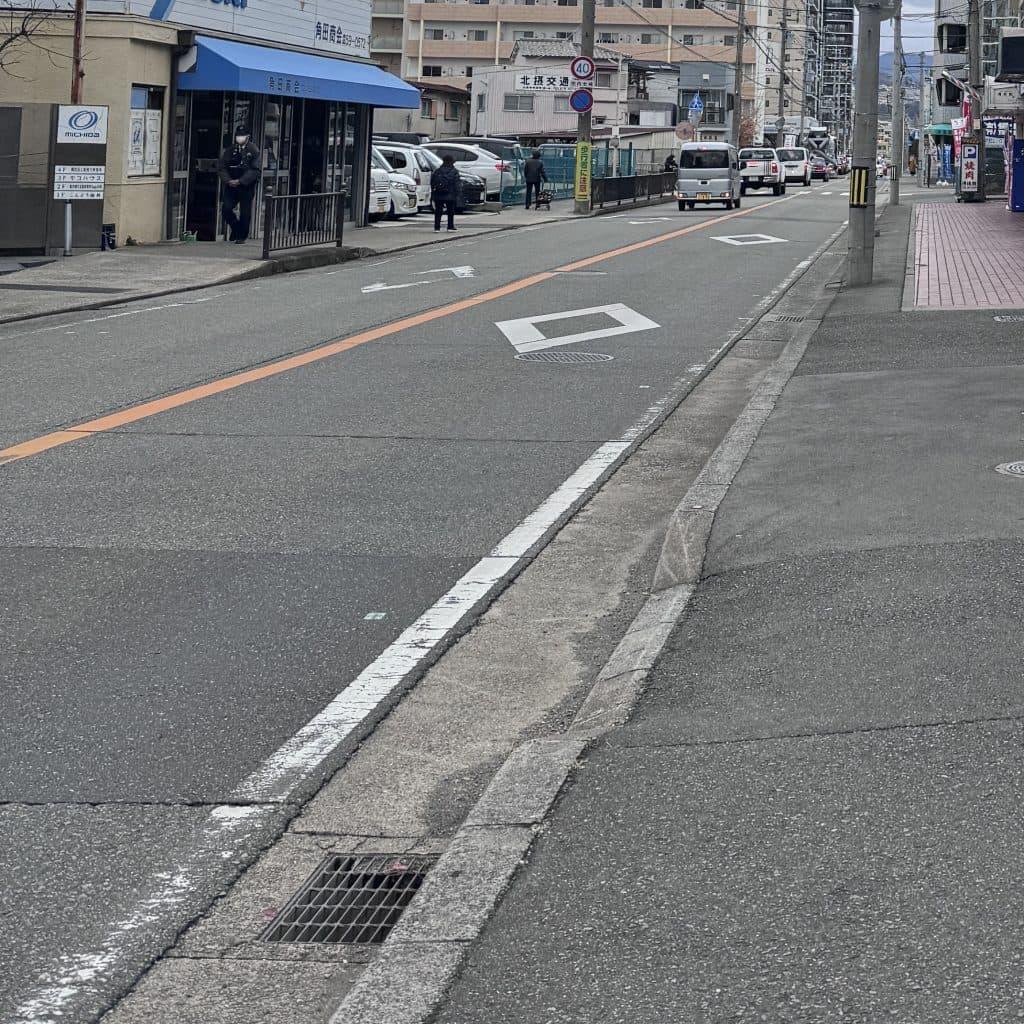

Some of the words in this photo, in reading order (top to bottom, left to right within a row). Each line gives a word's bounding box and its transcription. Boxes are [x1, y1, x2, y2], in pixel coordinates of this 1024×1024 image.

[576, 62, 590, 74] 40
[520, 75, 569, 87] 北摂交通
[964, 146, 976, 158] P
